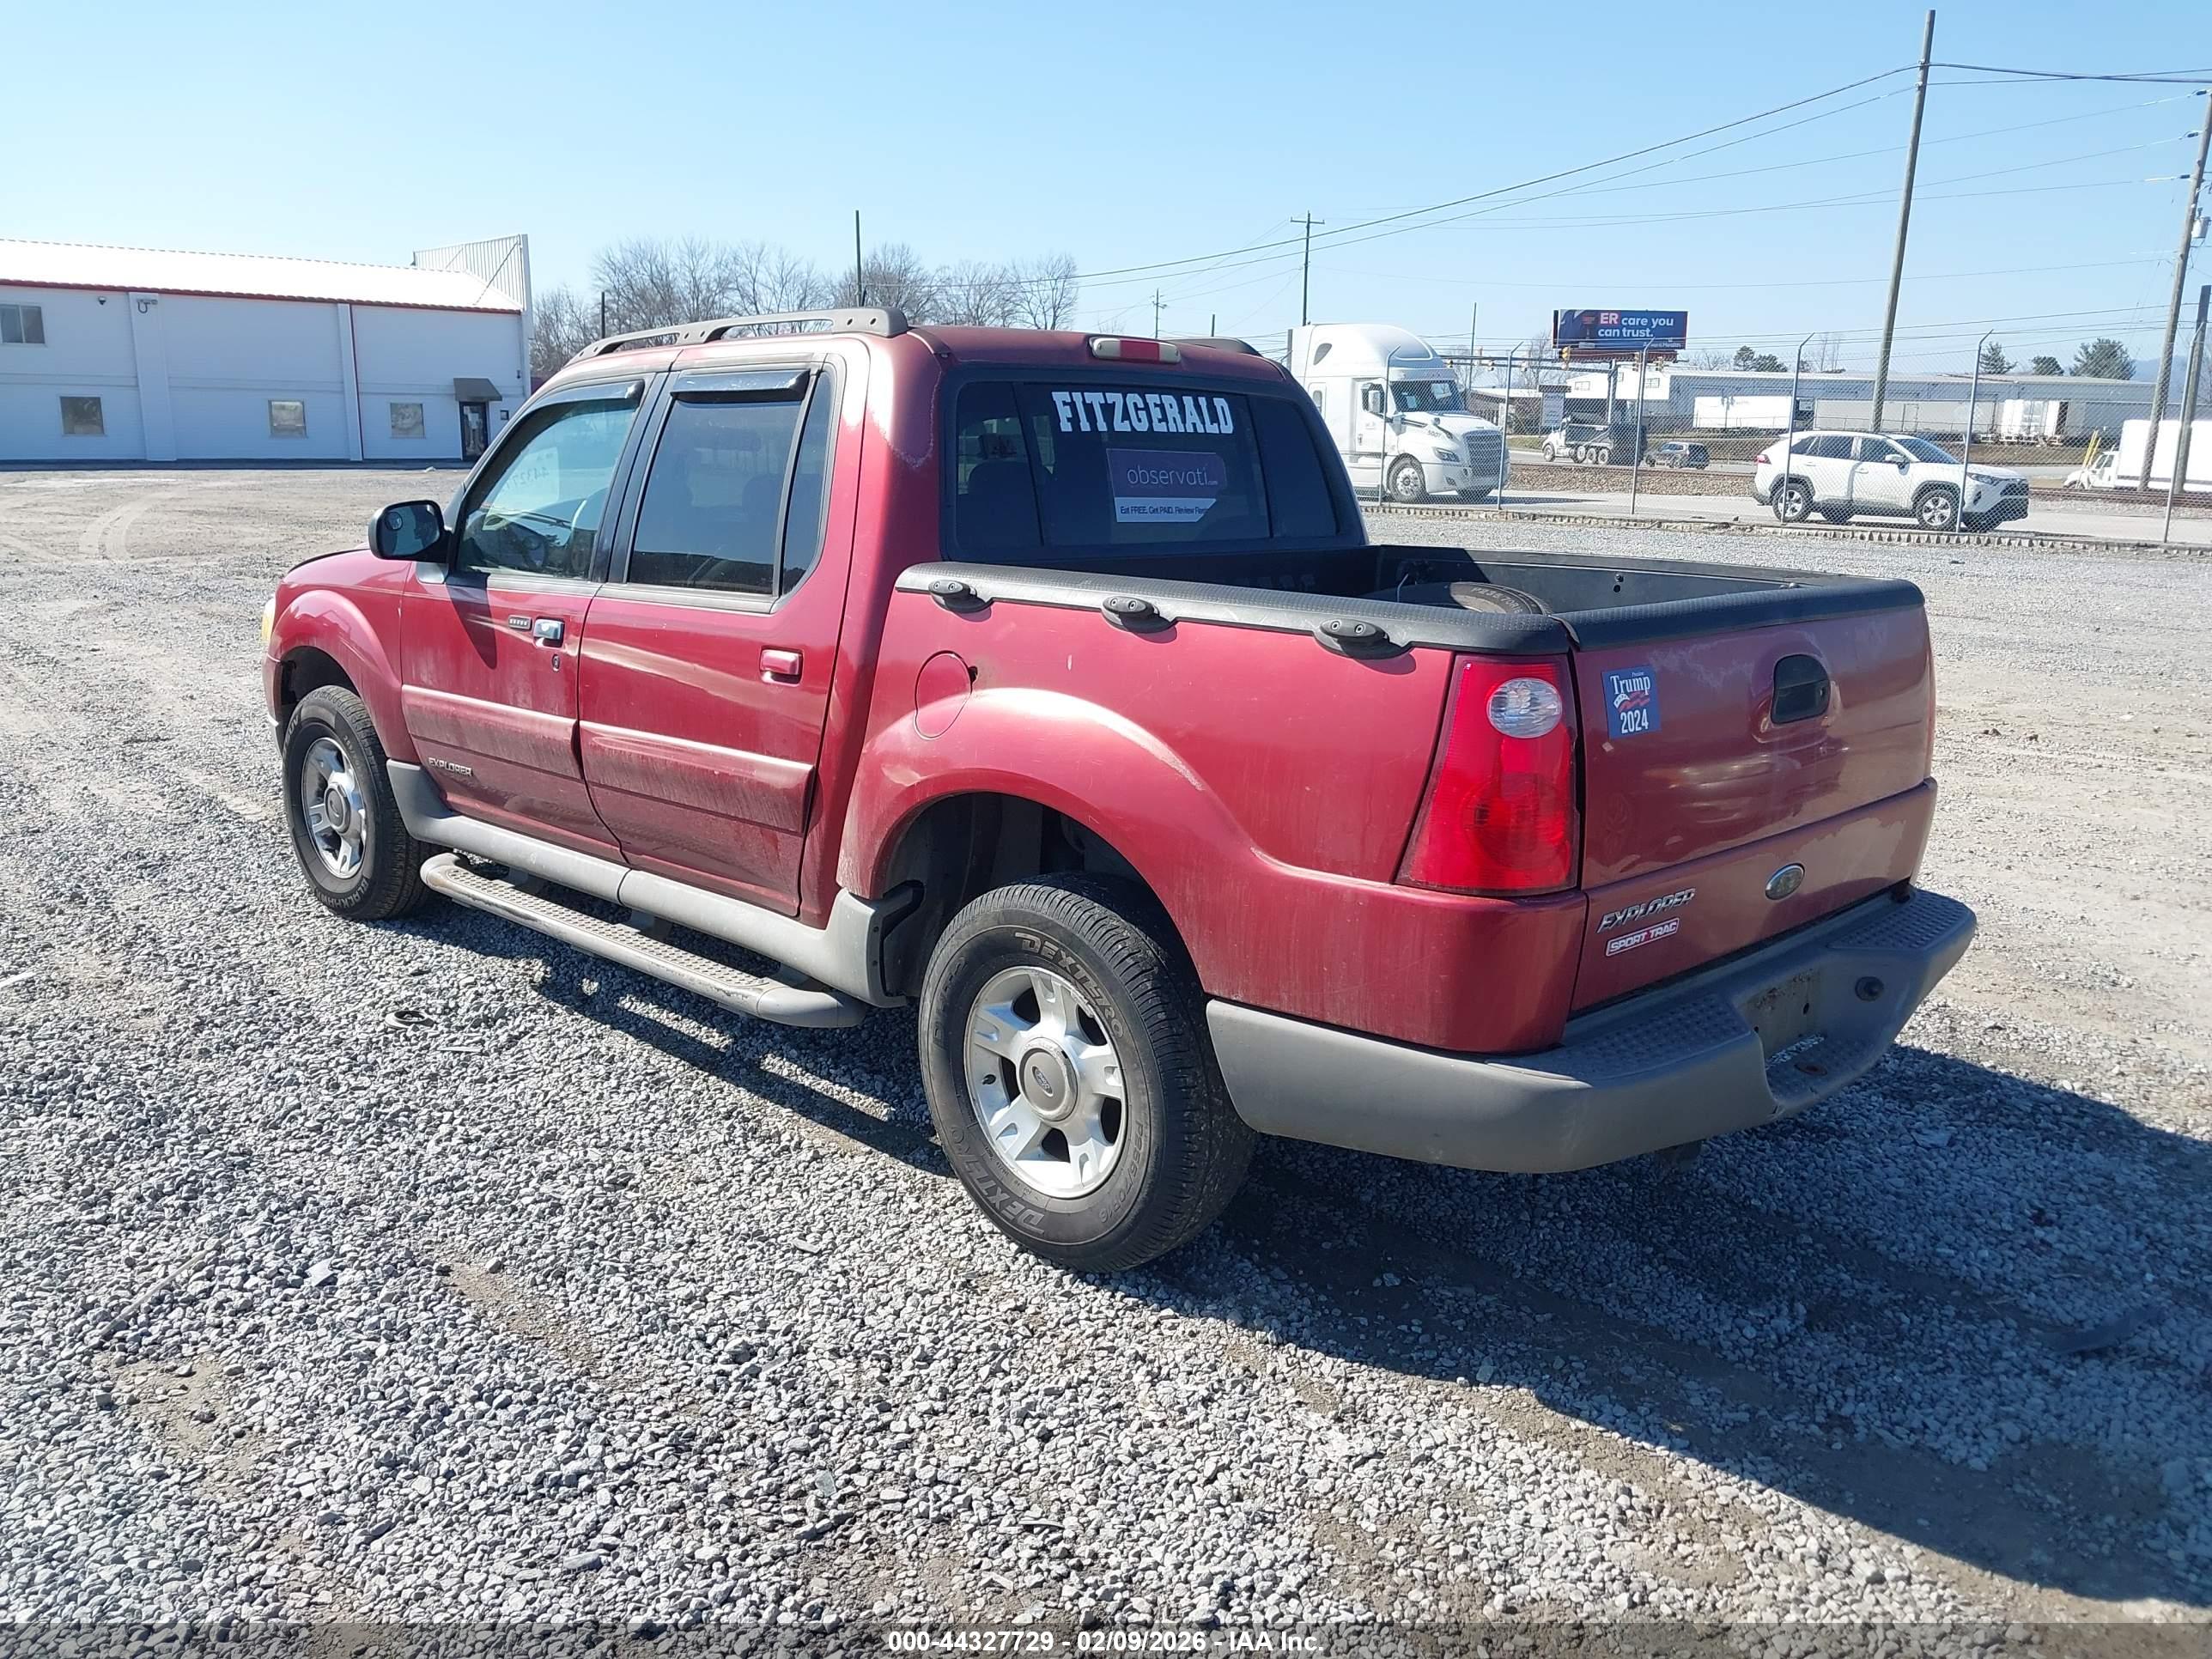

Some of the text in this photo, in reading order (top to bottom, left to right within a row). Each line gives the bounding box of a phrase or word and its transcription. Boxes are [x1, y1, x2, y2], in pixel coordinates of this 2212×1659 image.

[1598, 327, 1654, 337] can trust.
[1600, 313, 1674, 328] ER care you
[1051, 391, 1234, 434] FITZGERALD
[1120, 506, 1129, 514] Eat
[1610, 675, 1651, 696] Trump
[1620, 708, 1650, 734] 2024
[428, 757, 473, 776] EXPLORER
[1597, 888, 1696, 933] EXPLORER
[1609, 921, 1677, 952] SPORT TRAC
[1014, 932, 1125, 1039] DEXTERO
